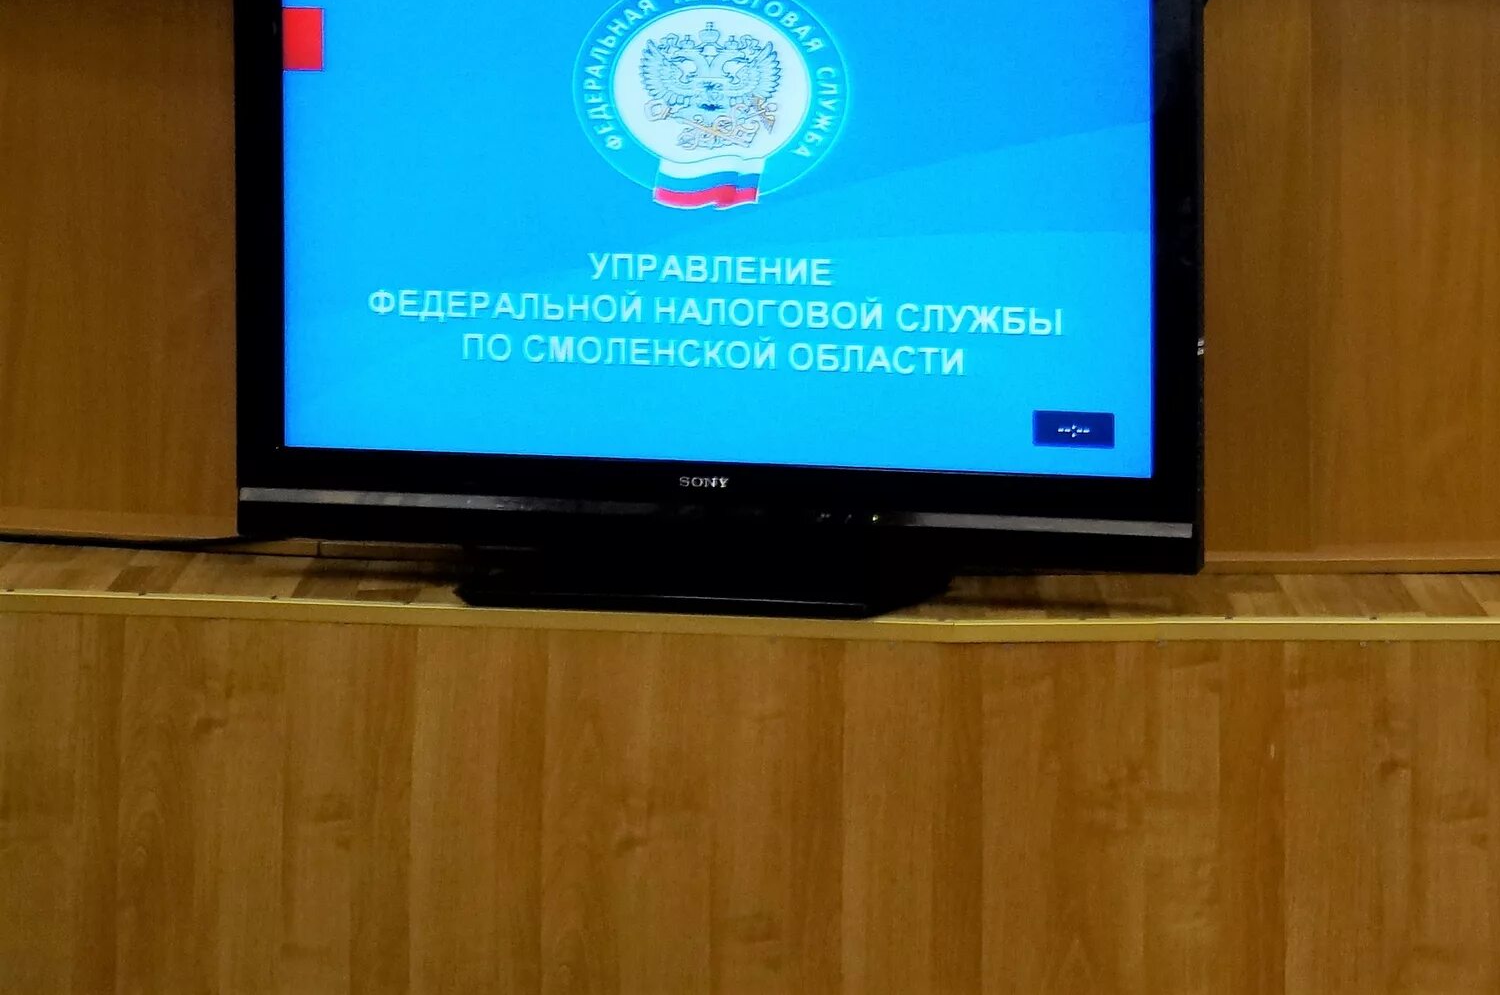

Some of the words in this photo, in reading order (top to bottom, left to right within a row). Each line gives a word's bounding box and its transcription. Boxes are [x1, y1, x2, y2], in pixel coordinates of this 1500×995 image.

[791, 66, 840, 158] СЛУЖБА
[588, 252, 834, 287] УПРАВЛЕНИЕ
[368, 288, 644, 325] ФЕДЕРАЛЬНОЙ
[654, 295, 884, 332] НАЛОГОВОЙ
[895, 303, 1064, 336] СЛУЖБЫ
[461, 333, 513, 362] ПО
[523, 334, 778, 371] СМОЛЕНСКОЙ
[787, 342, 966, 377] ОБЛАСТИ
[679, 476, 730, 488] SONY
